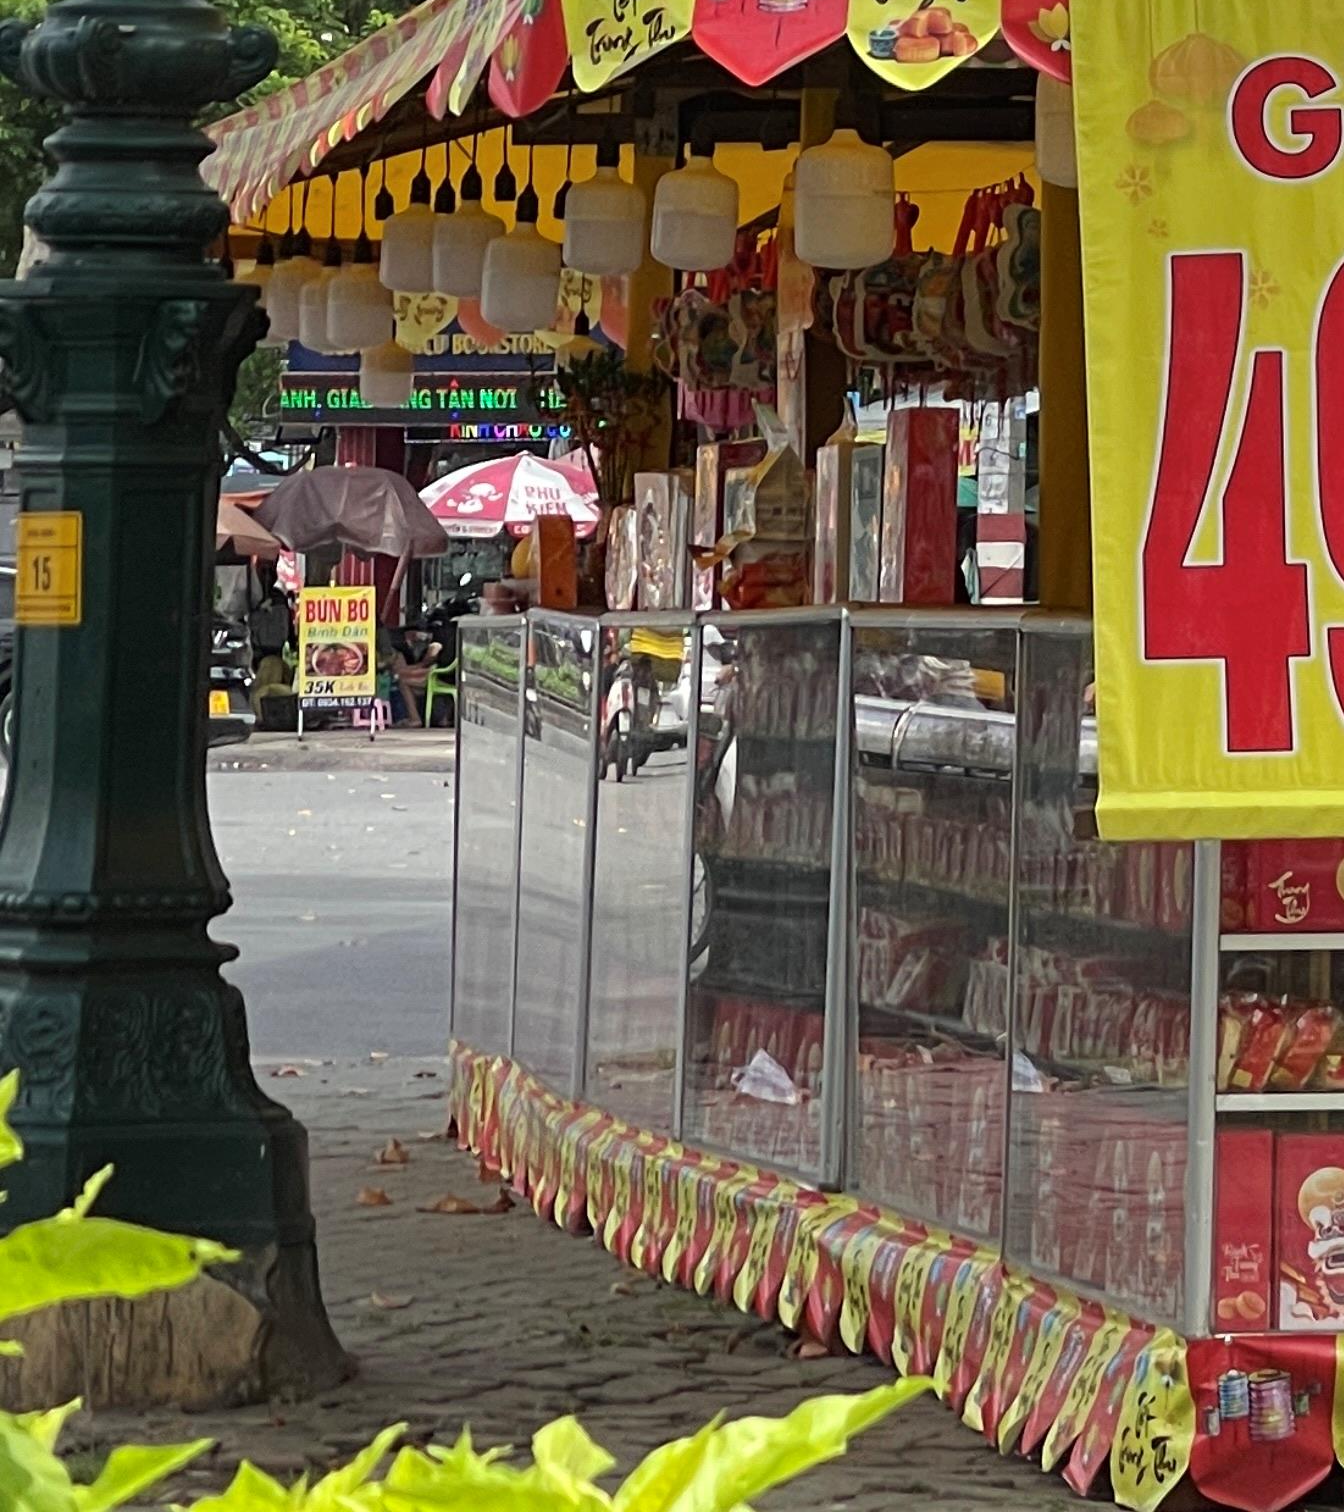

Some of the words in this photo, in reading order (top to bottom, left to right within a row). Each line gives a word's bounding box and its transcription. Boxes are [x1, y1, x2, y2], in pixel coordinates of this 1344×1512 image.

[326, 388, 374, 409] GIA
[32, 555, 52, 592] 15
[304, 680, 336, 695] 35K
